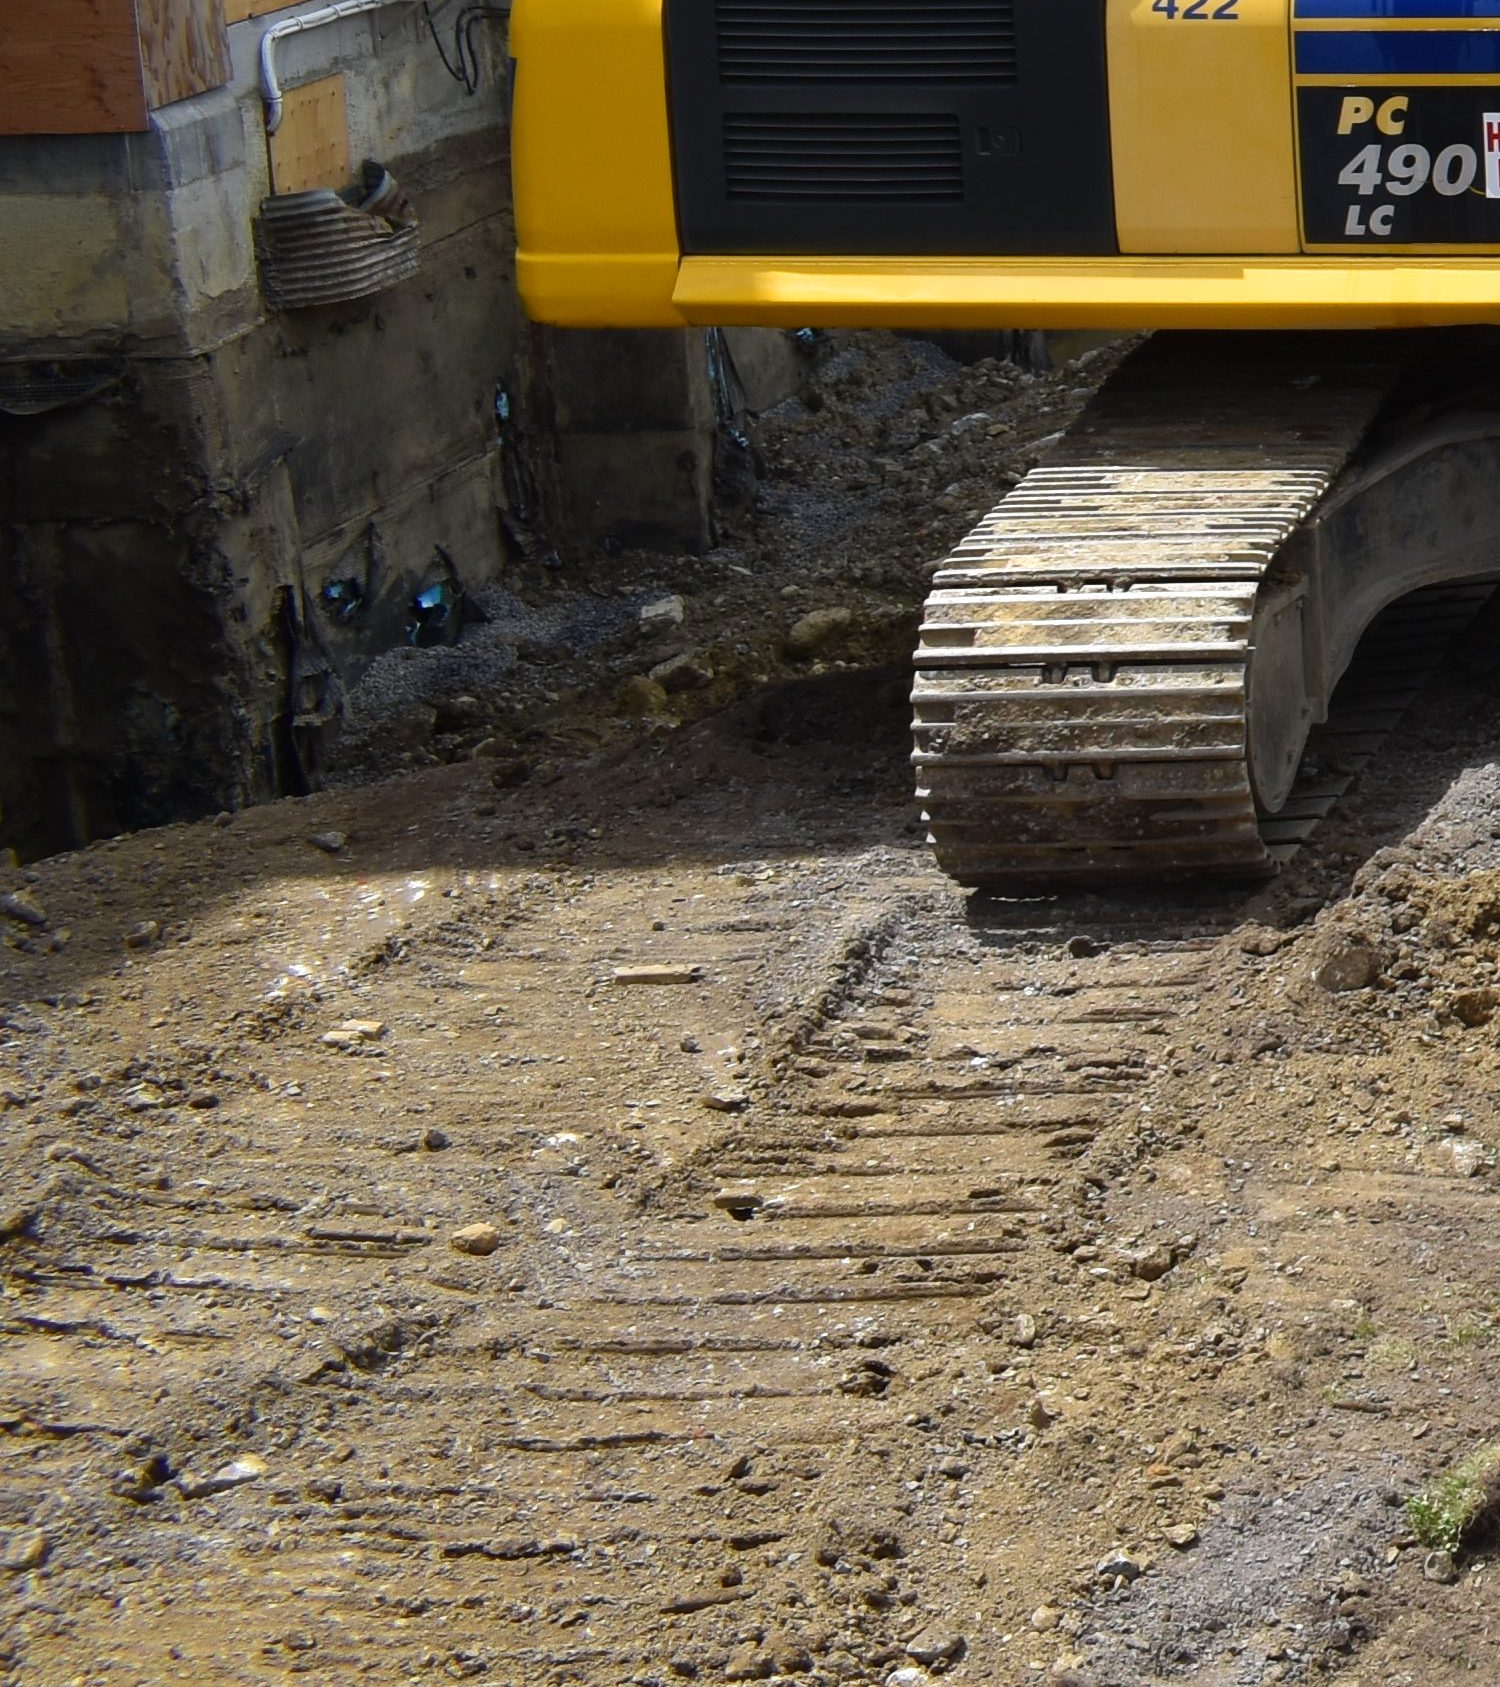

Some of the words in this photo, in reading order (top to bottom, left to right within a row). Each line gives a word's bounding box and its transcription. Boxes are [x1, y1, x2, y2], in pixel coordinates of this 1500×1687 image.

[1336, 96, 1409, 136] PC
[1337, 143, 1478, 196] 490
[1344, 204, 1395, 236] LC
